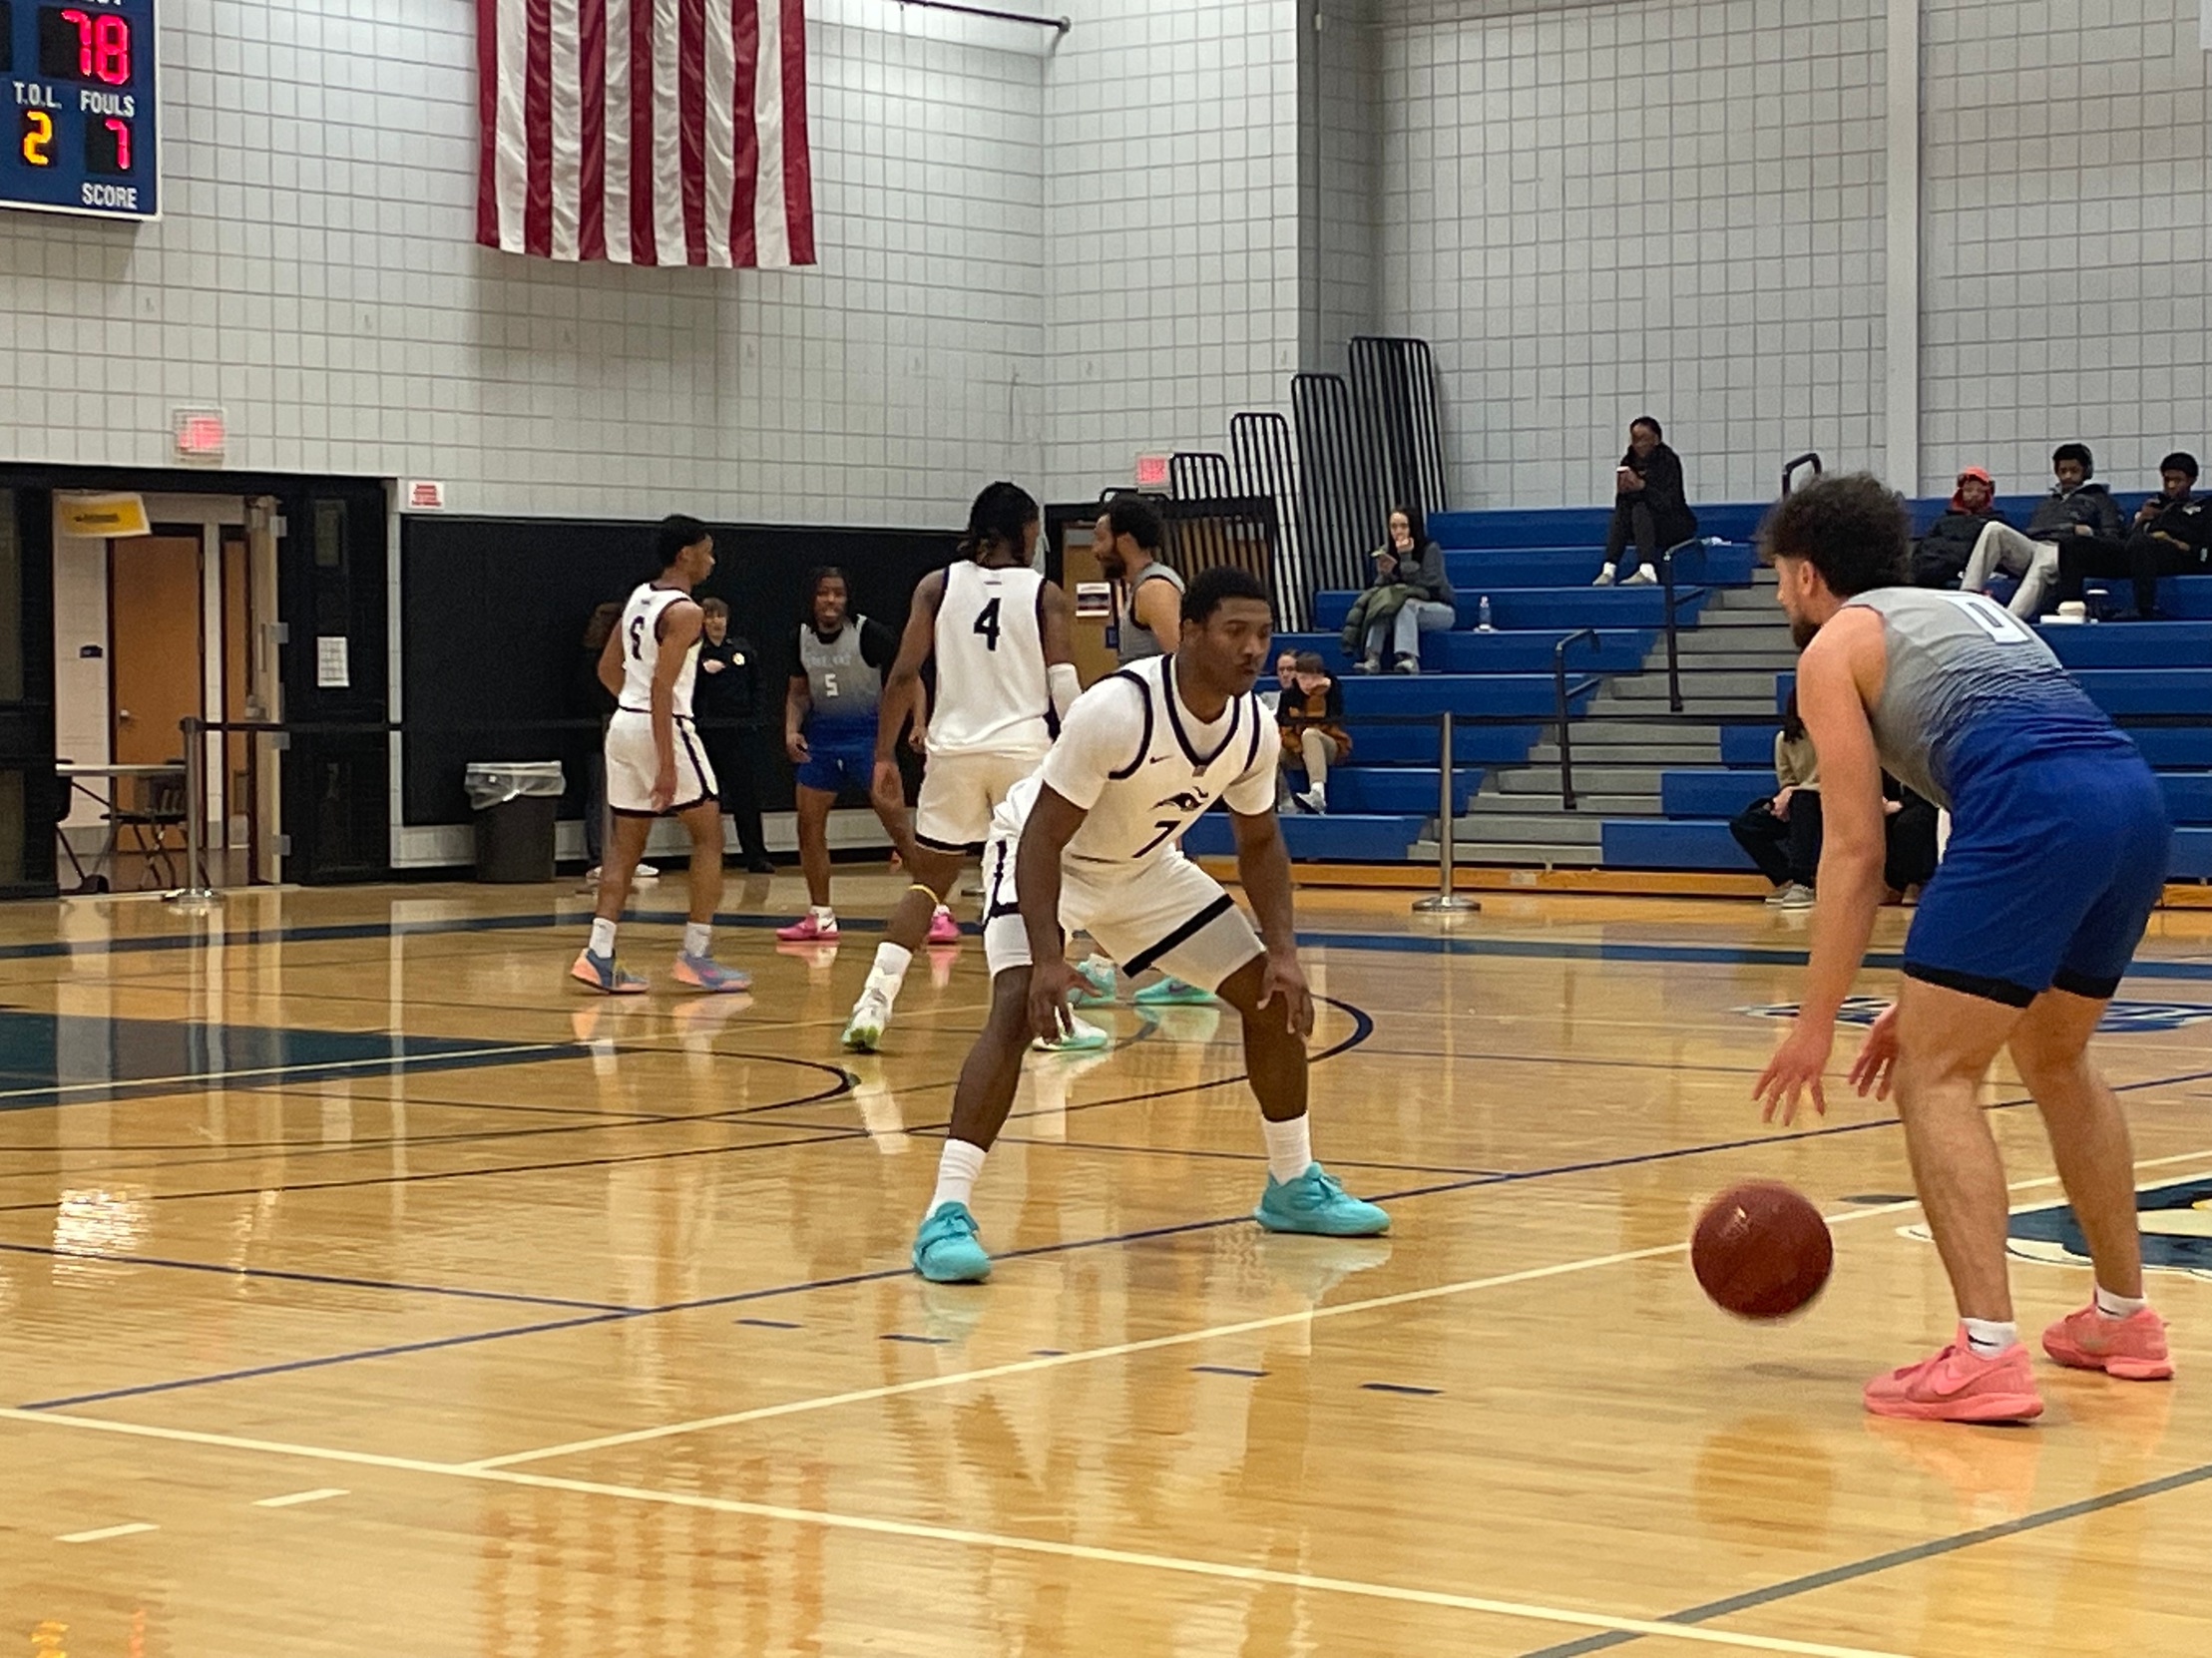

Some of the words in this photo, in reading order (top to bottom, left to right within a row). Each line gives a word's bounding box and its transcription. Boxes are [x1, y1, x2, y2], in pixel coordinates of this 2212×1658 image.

[61, 9, 131, 85] 78
[13, 81, 62, 108] T.O.L.
[80, 91, 136, 118] FOULS
[23, 112, 52, 166] 2
[105, 120, 131, 170] 7
[83, 184, 137, 208] SCORE
[974, 598, 1001, 651] 4
[824, 673, 839, 696] 5
[1131, 821, 1181, 858] 7
